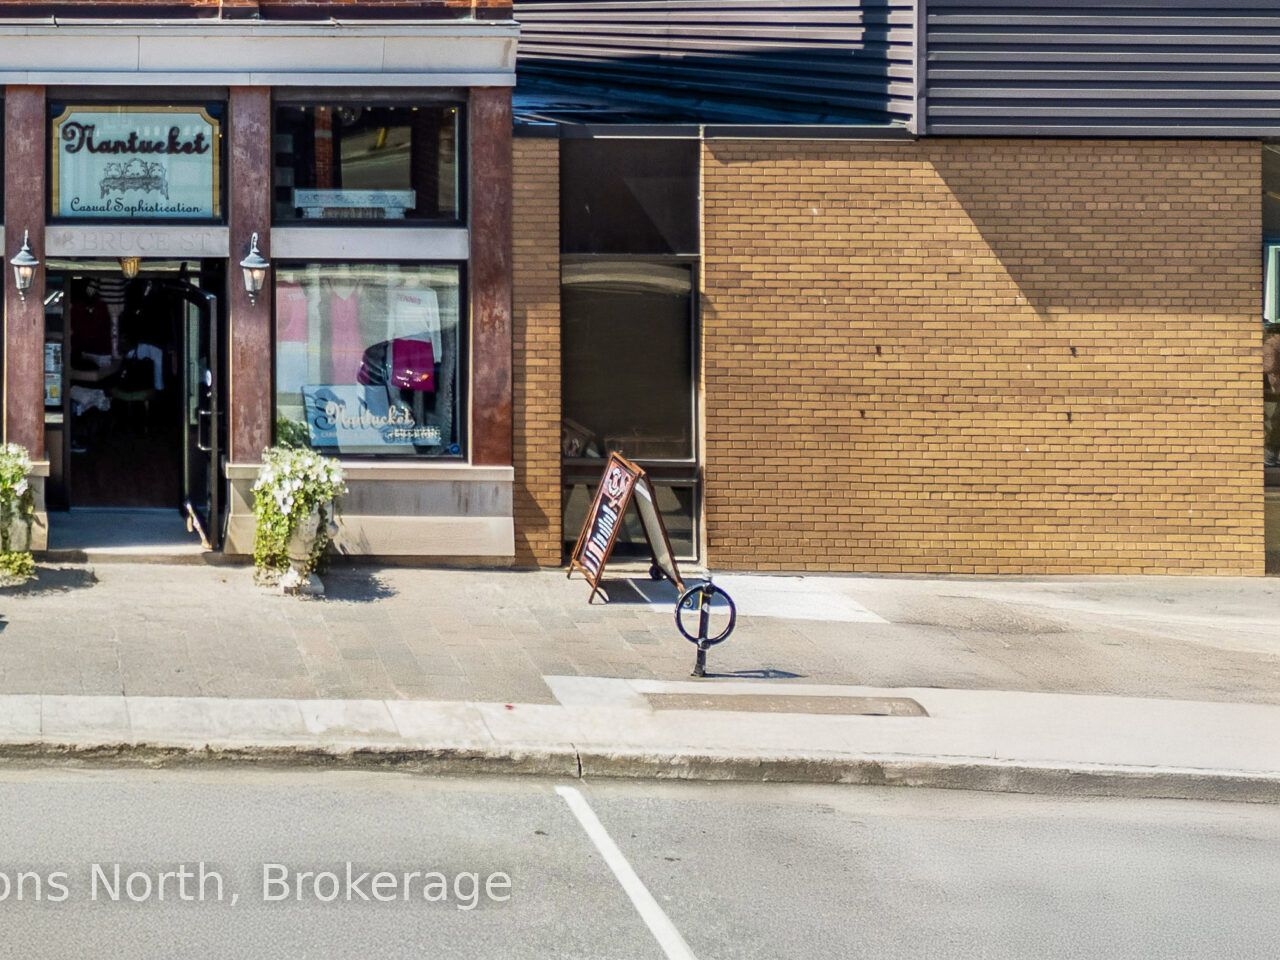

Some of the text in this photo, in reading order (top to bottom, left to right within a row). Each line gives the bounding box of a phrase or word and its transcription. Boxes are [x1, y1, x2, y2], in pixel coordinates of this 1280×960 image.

[62, 121, 210, 155] Nantucket
[70, 196, 200, 216] Casual Sophistication
[82, 231, 169, 251] BRUCE
[180, 231, 211, 251] ST
[325, 402, 415, 428] Nantucket
